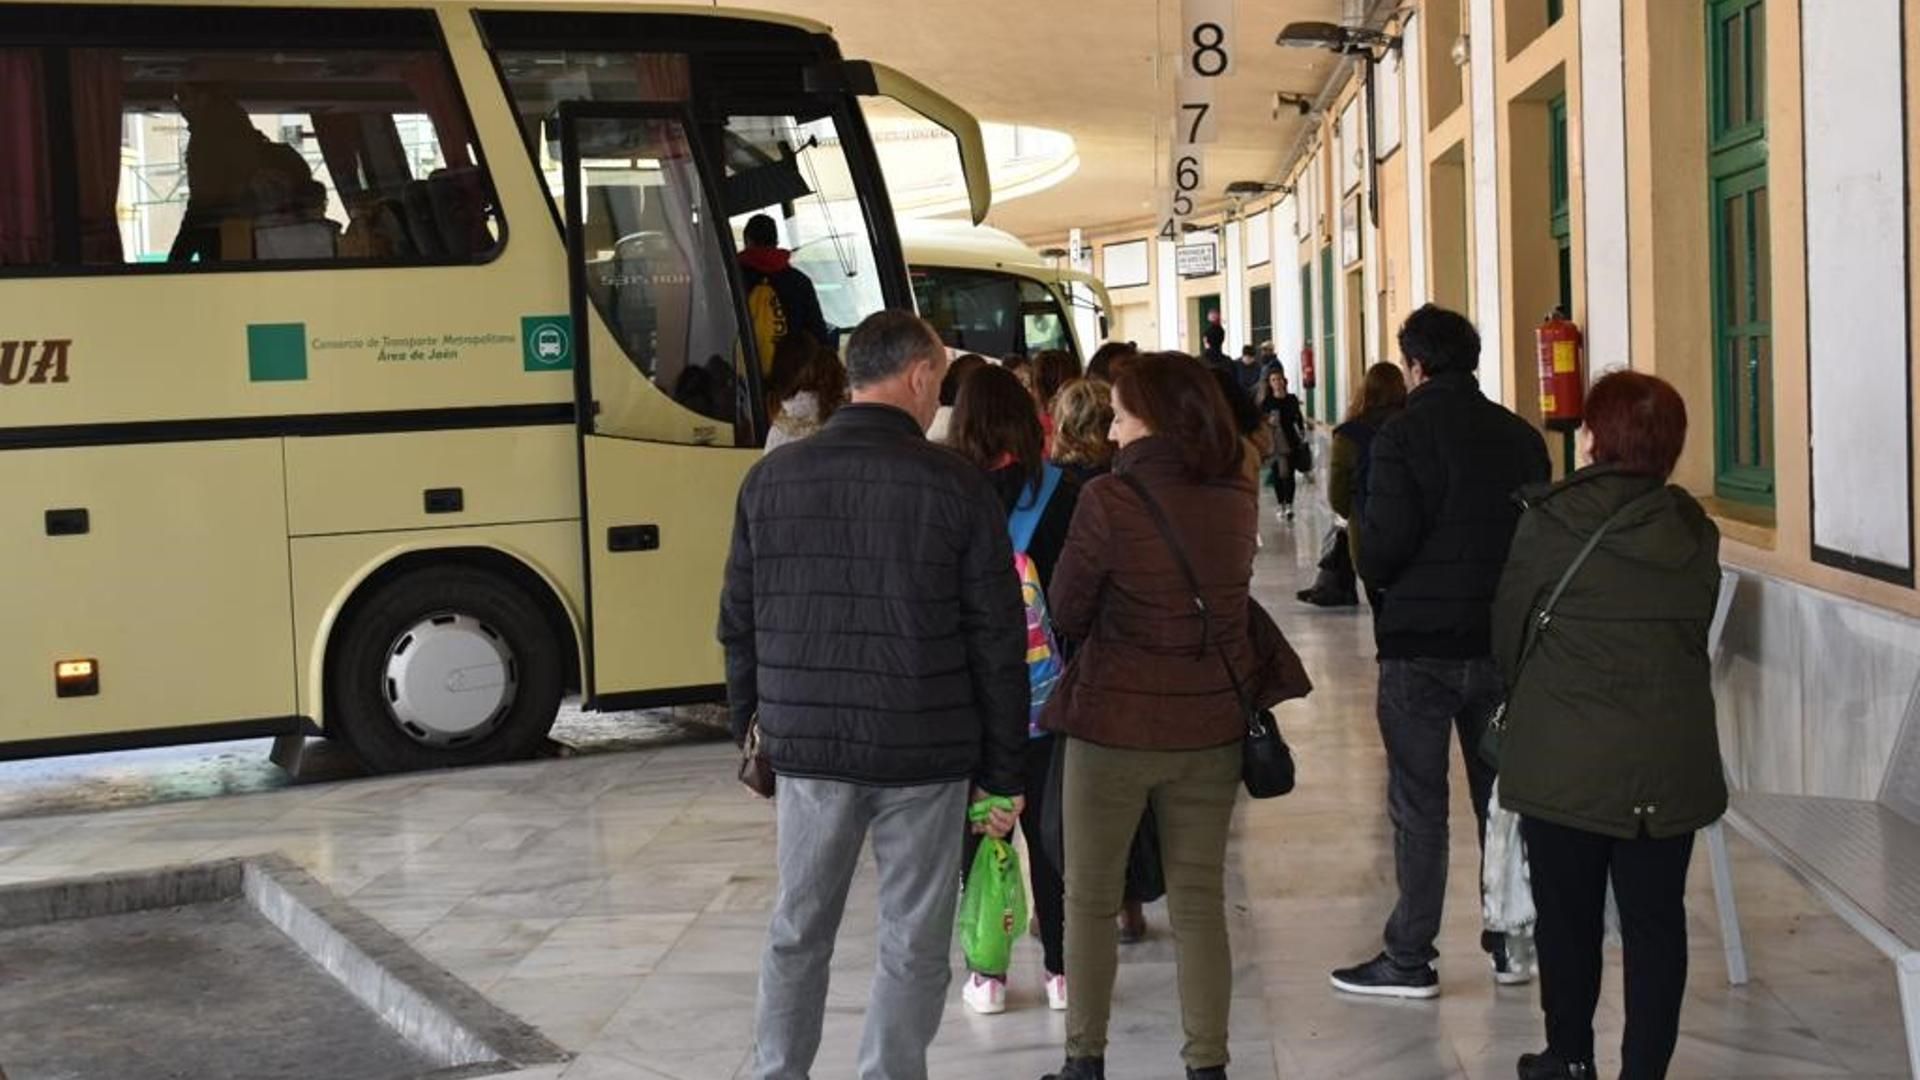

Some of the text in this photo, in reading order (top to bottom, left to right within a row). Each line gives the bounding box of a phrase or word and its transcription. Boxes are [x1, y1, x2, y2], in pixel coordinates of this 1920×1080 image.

[1192, 22, 1228, 77] 8
[1182, 103, 1210, 144] 7
[1176, 156, 1199, 191] 6
[1173, 189, 1193, 216] 5
[1159, 218, 1178, 241] 4
[366, 337, 379, 348] de
[381, 335, 437, 349] Transporte
[442, 333, 516, 346] Metropolitano
[377, 348, 458, 362] Área de Jaén
